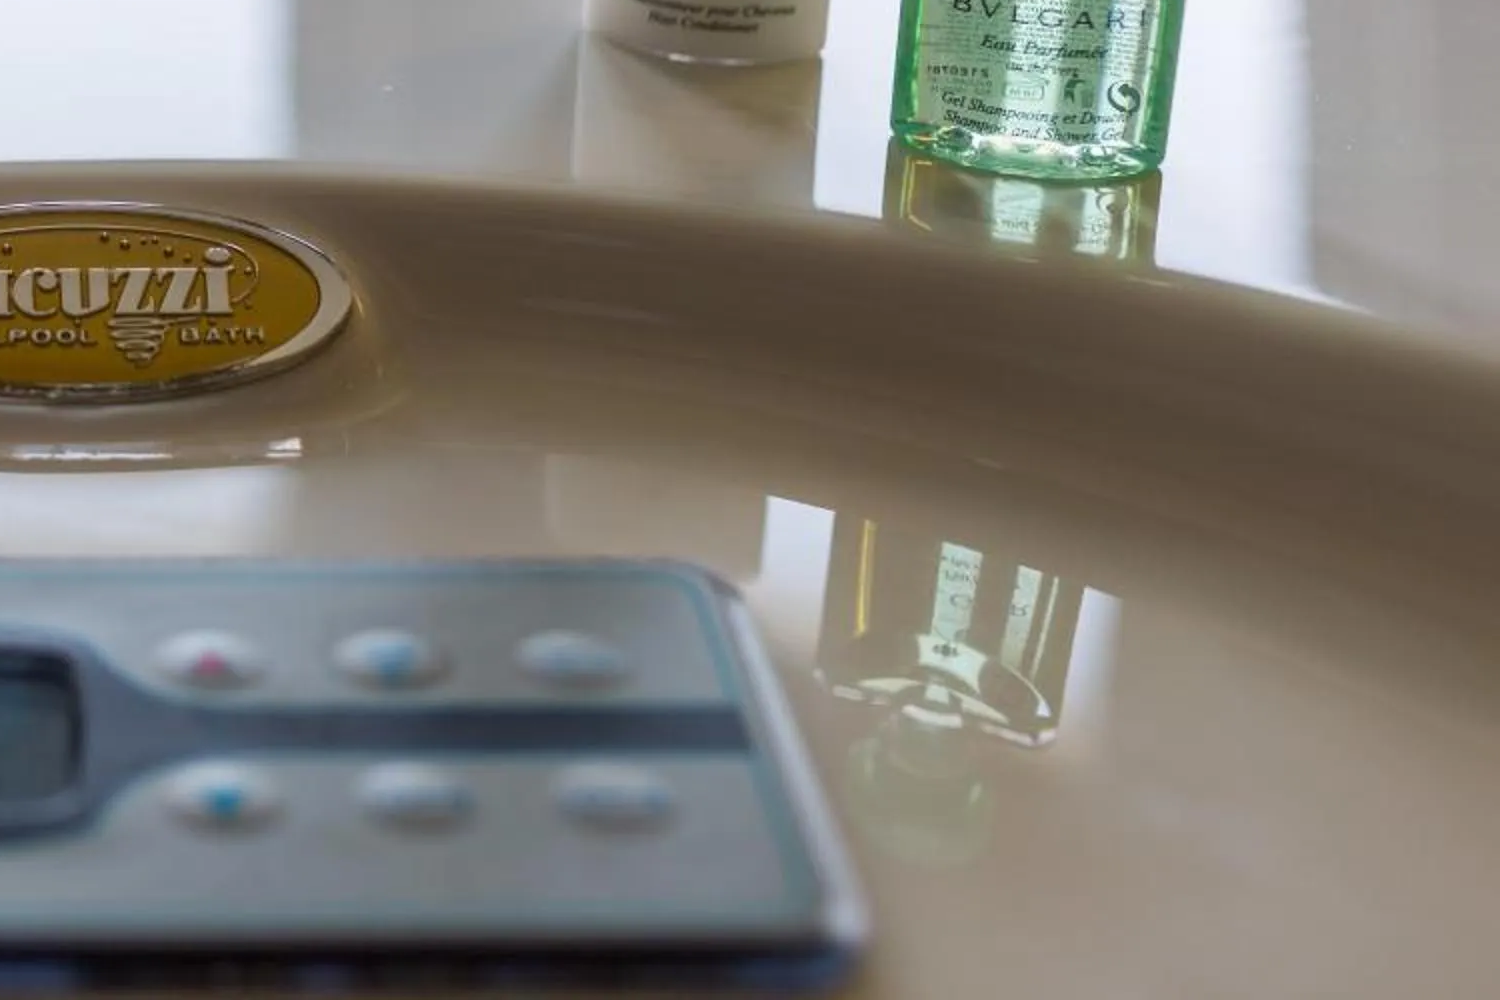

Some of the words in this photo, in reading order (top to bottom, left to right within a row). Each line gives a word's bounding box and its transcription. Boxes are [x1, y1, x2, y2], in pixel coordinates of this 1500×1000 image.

[980, 34, 1016, 52] Eau
[941, 91, 967, 108] Gel
[178, 326, 265, 345] BATH
